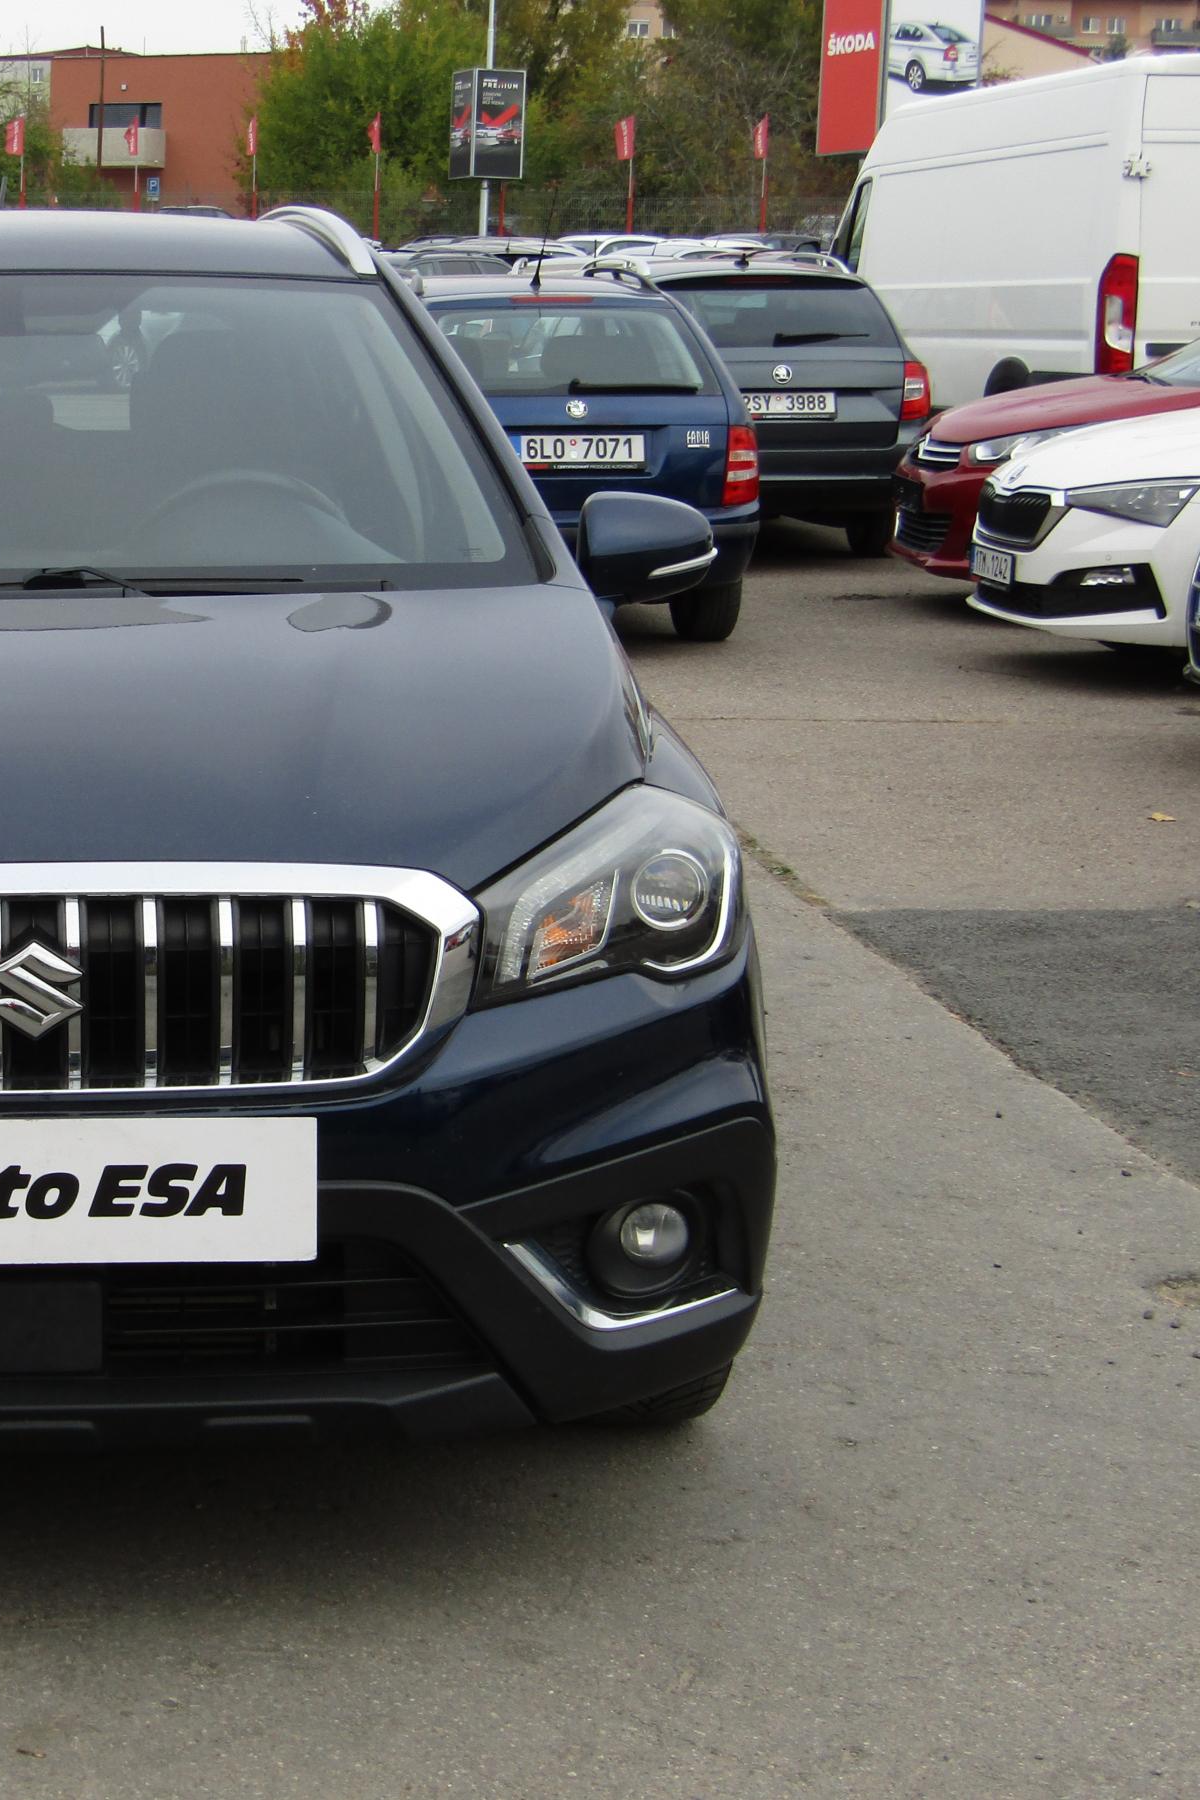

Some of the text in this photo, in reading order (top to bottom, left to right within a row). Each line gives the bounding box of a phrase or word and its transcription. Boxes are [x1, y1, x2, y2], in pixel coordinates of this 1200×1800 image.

[827, 31, 876, 57] ŠKODA
[785, 394, 827, 411] 3988
[526, 437, 634, 460] 6L0 7071
[88, 1163, 247, 1217] ESA
